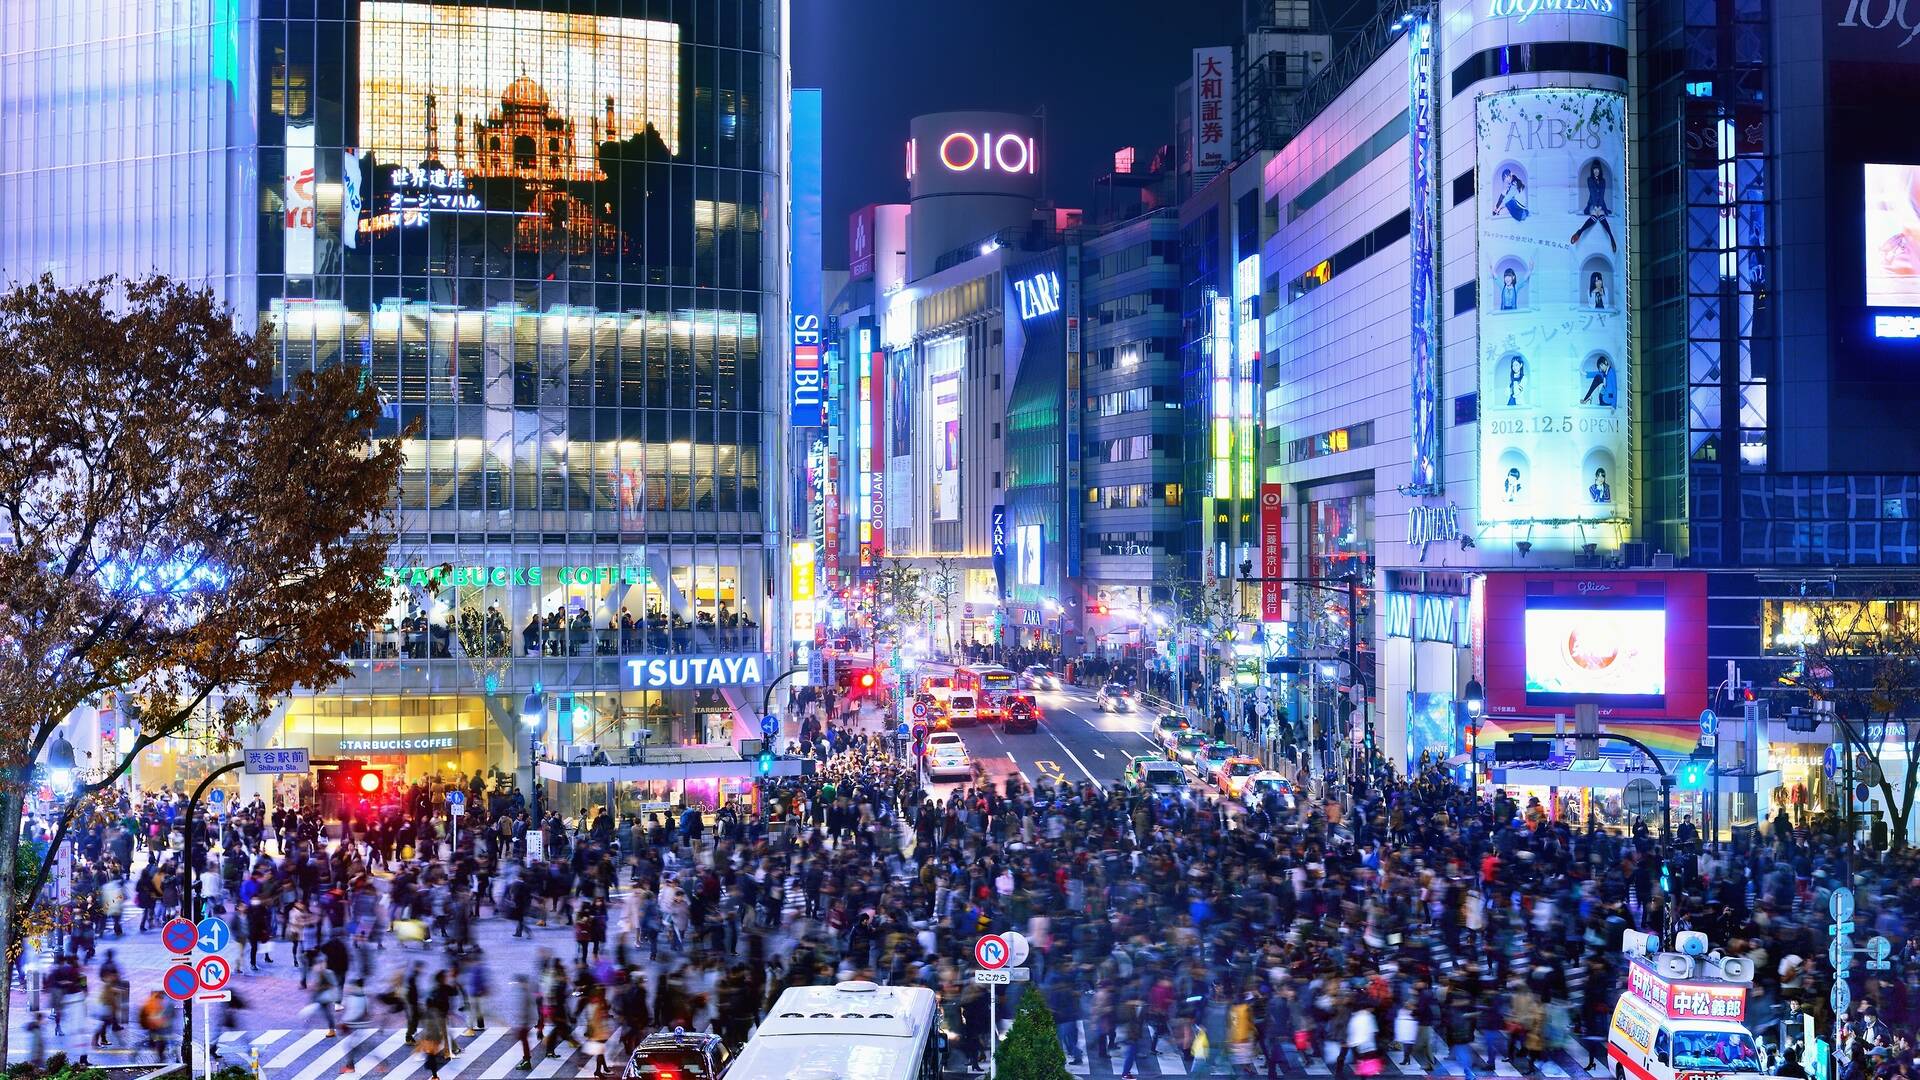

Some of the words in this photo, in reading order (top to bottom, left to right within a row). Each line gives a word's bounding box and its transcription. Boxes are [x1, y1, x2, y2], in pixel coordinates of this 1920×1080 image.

[1201, 56, 1223, 144] 大和証券
[1505, 118, 1601, 151] AKB48
[391, 169, 466, 188] 世界遺産
[390, 193, 480, 208] タージ・マハル
[1015, 271, 1060, 320] ZARA
[795, 315, 819, 405] SEIBU
[1491, 416, 1573, 434] 2012.12.5
[994, 513, 1004, 555] ZARA
[558, 566, 652, 585] COFFEE
[1022, 609, 1041, 625] ZARA
[627, 657, 761, 687] TSUTAYA
[340, 740, 412, 750] STARBUCKS
[413, 738, 453, 748] COFFEE
[249, 751, 304, 764] 渋谷駅前
[258, 764, 284, 772] Shibuya
[977, 973, 1008, 982] ここから
[1673, 991, 1742, 1017] 中松義郎
